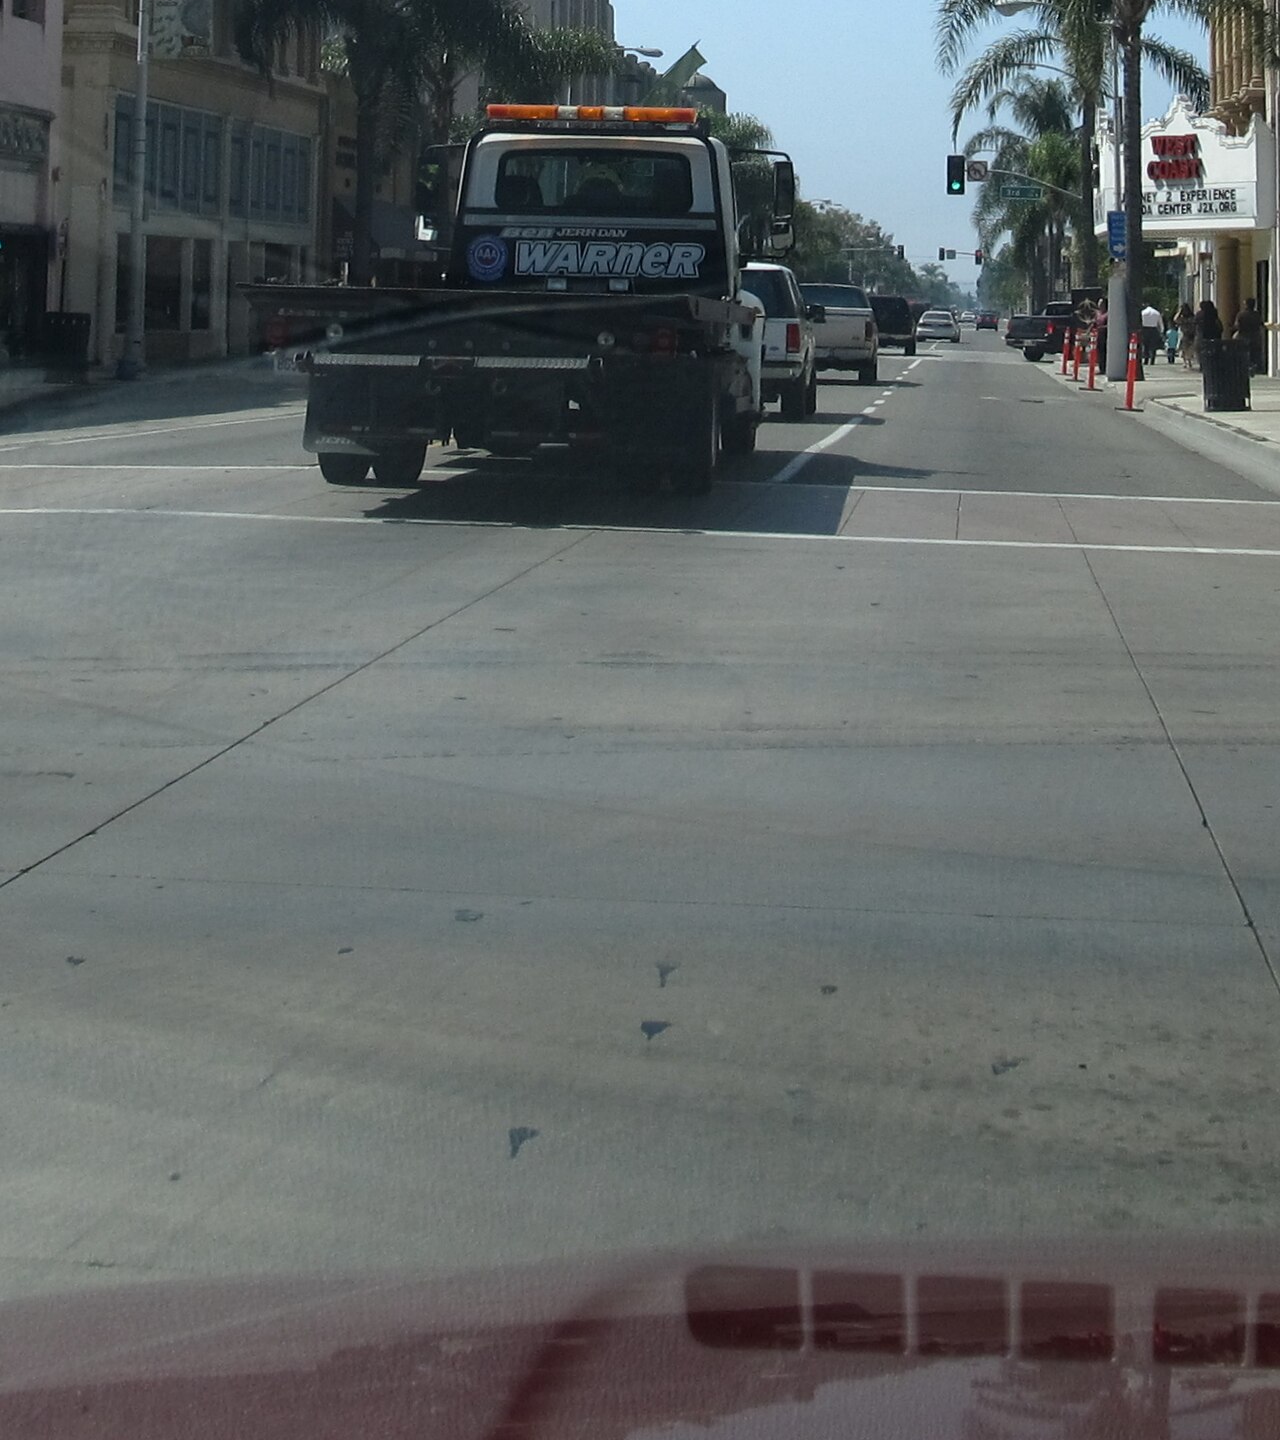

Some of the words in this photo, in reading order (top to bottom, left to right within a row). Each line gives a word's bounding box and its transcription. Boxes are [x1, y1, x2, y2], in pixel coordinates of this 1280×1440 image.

[1150, 134, 1198, 156] WEST
[1147, 158, 1203, 180] COAST
[1166, 191, 1173, 202] 2
[1180, 189, 1237, 202] EXPERIENCE
[1157, 203, 1193, 215] CENTER
